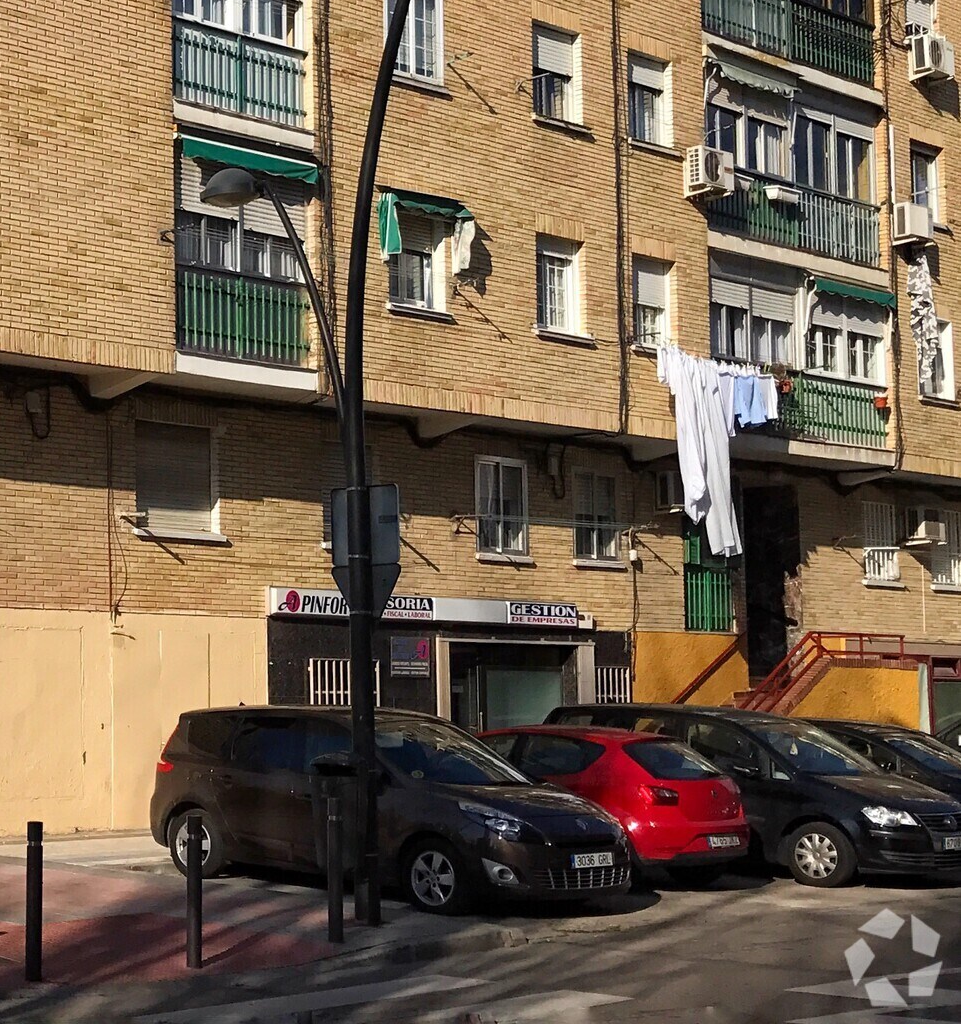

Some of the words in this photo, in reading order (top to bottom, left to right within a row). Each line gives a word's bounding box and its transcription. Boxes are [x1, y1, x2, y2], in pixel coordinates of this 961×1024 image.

[386, 597, 431, 610] SORIA
[527, 616, 575, 624] EMPRESAS
[577, 855, 595, 866] 3036
[598, 854, 611, 865] GRL
